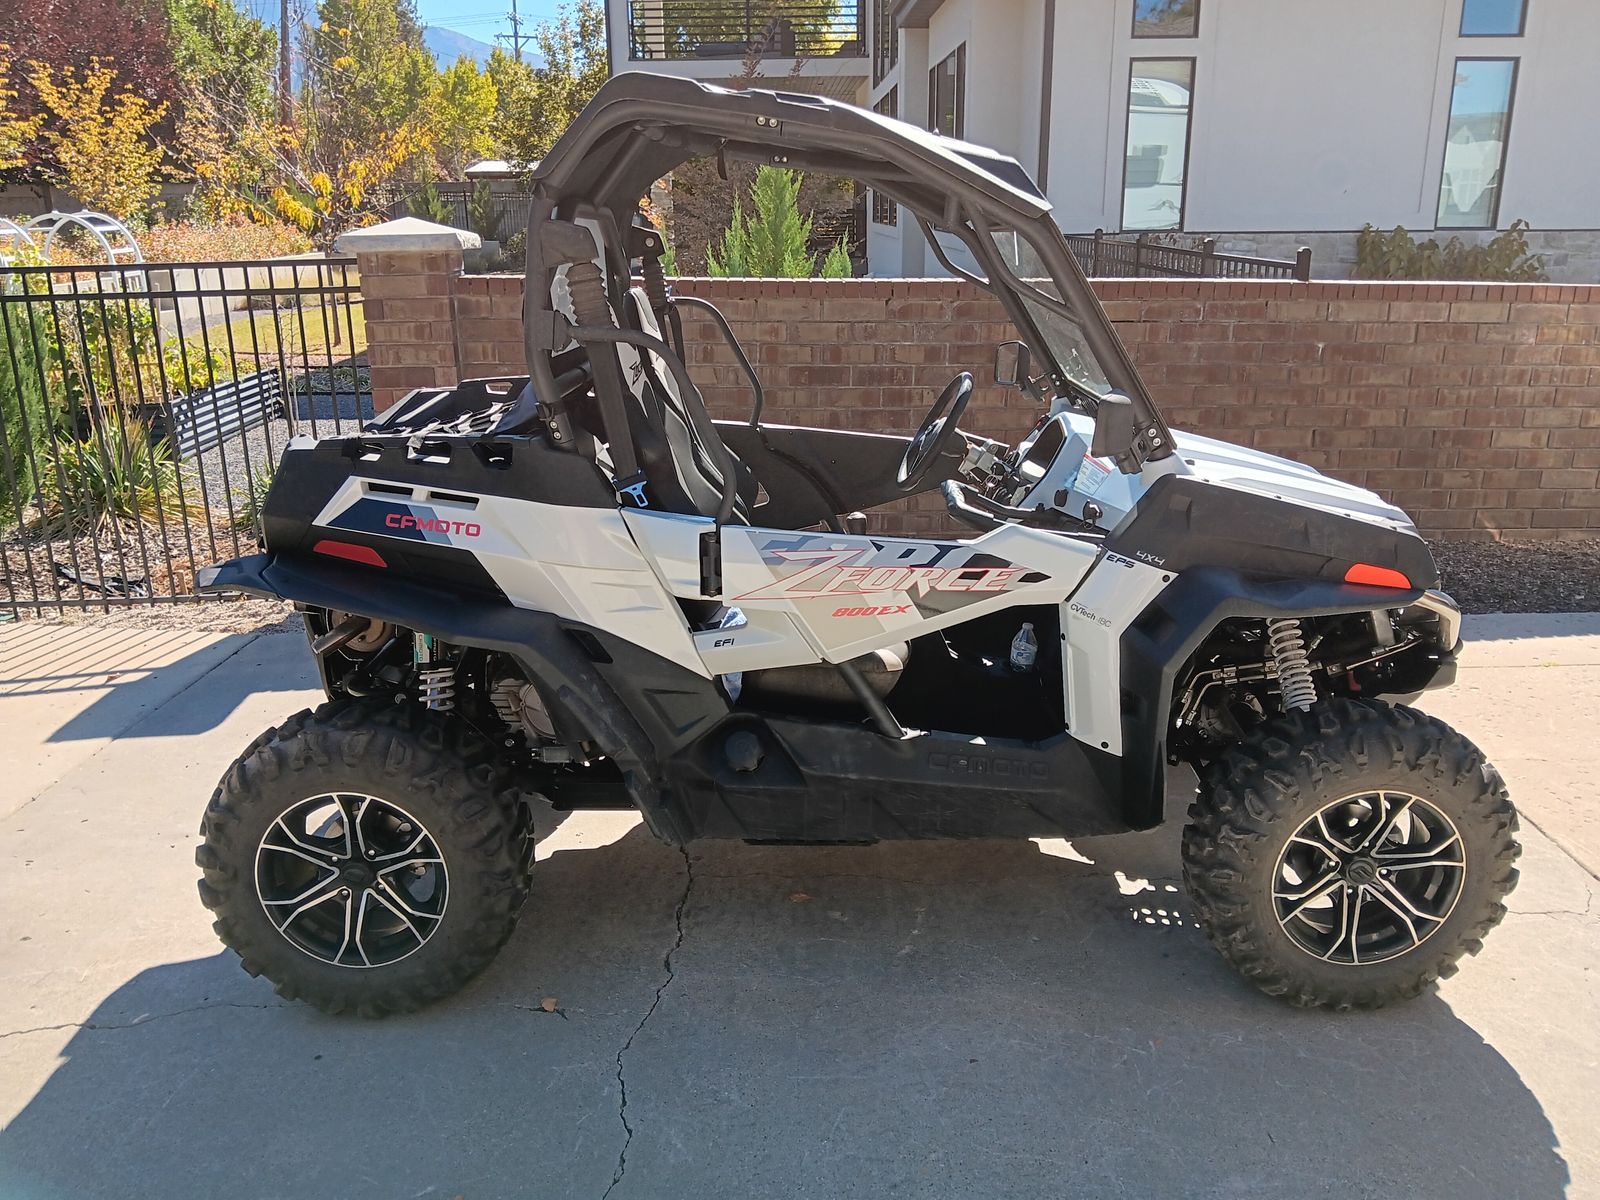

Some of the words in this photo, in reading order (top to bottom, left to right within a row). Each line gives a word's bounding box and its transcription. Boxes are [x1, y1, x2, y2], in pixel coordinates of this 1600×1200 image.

[385, 513, 480, 537] CFMOTO
[1106, 554, 1136, 569] EPS
[1070, 603, 1096, 621] CVTech
[713, 638, 735, 647] EFI
